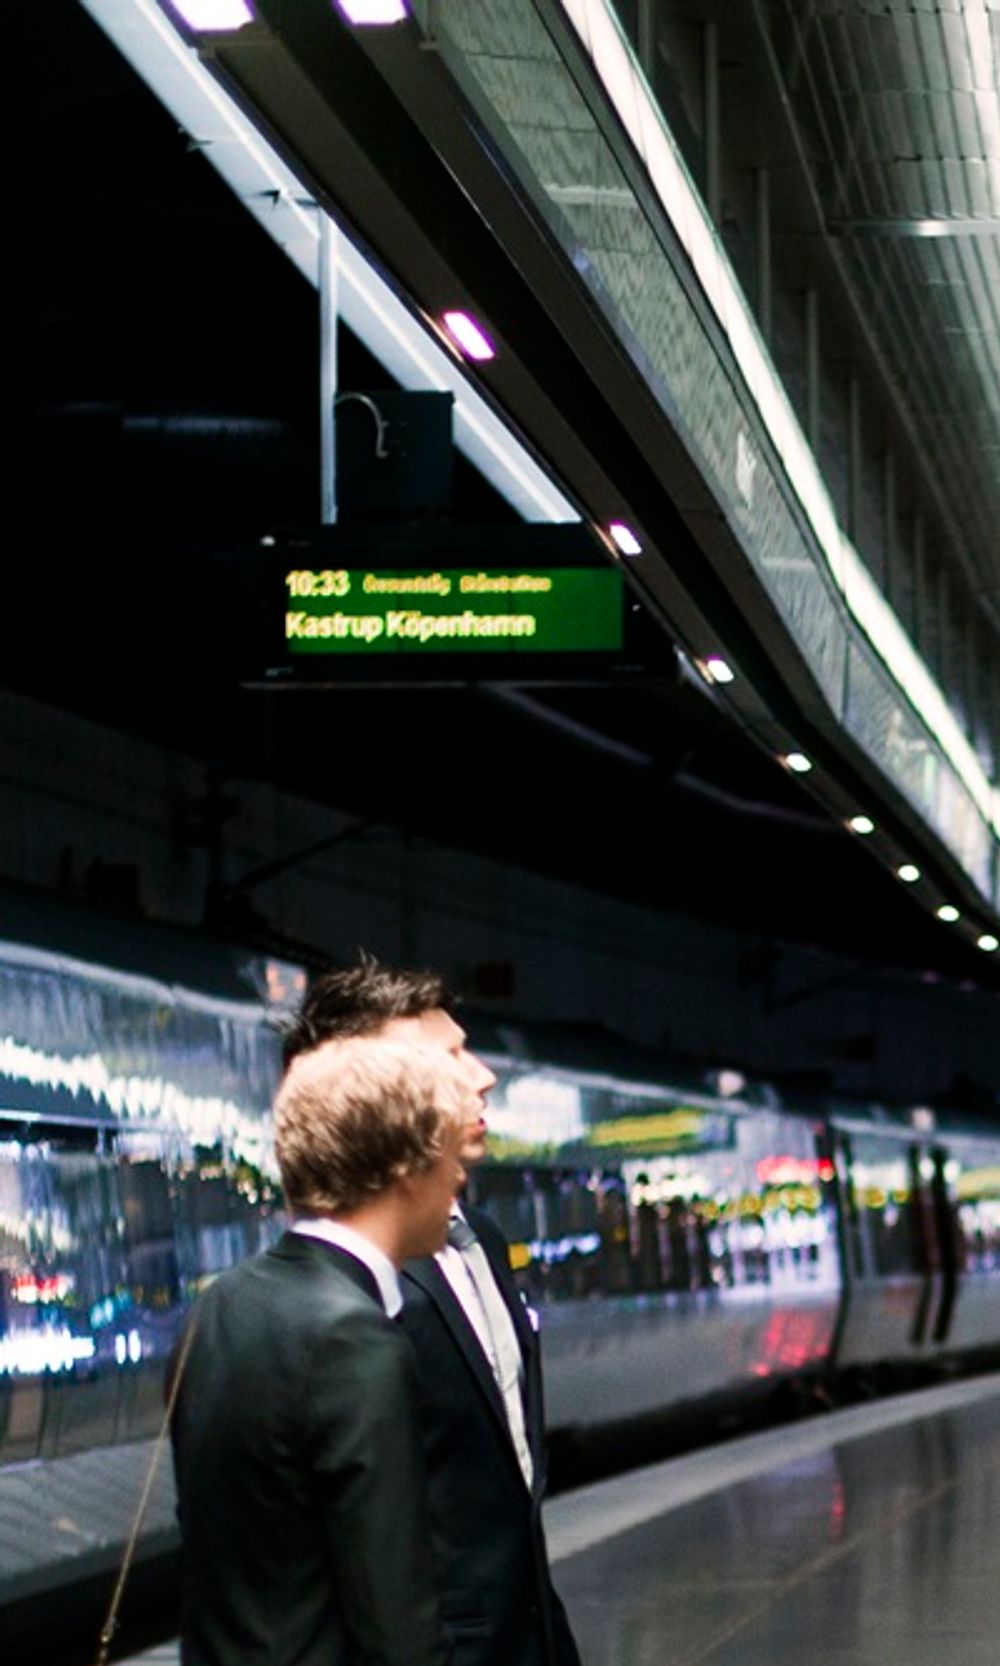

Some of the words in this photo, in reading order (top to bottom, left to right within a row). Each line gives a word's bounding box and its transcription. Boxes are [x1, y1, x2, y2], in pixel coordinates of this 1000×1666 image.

[285, 570, 350, 597] 10:33
[285, 611, 384, 643] Kastrup
[386, 610, 537, 643] Köpenhamn
